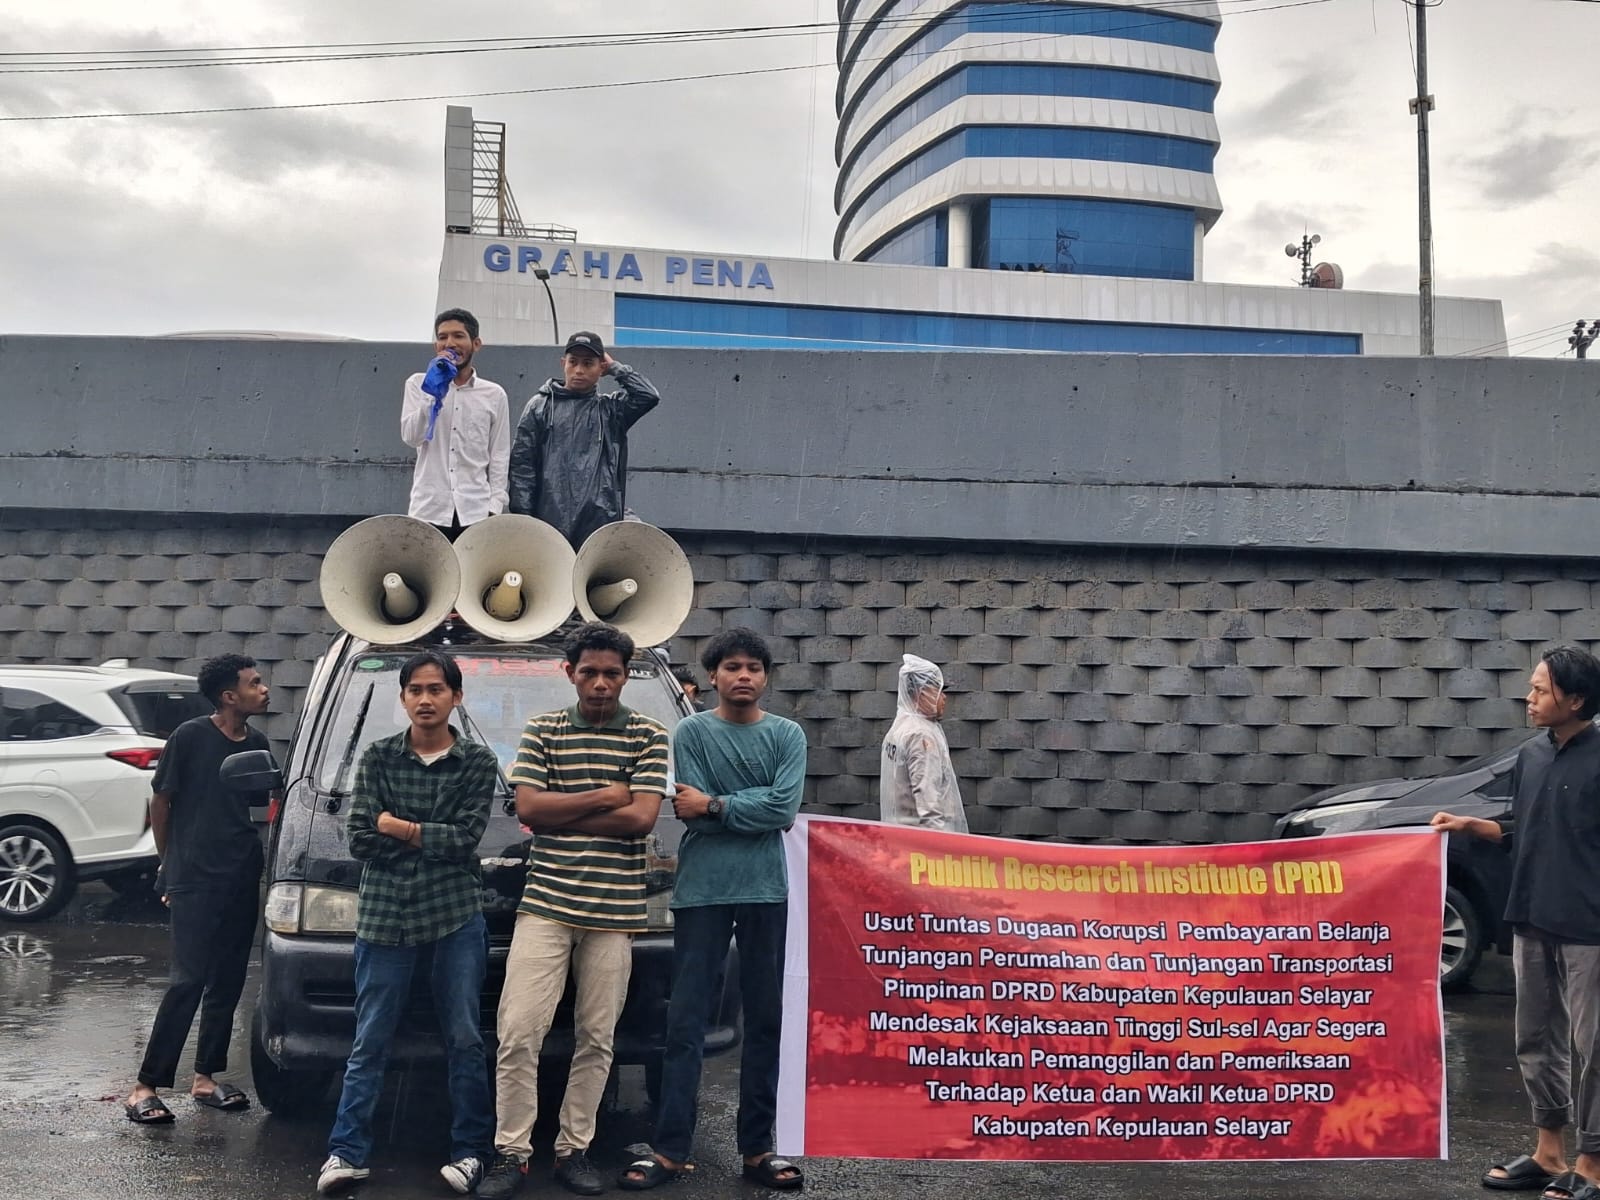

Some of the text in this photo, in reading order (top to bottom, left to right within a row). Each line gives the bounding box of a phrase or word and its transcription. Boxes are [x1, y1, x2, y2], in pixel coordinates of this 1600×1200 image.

[484, 244, 775, 290] GRAHA PENA
[910, 853, 1344, 895] Publik Research Institute (PRI)
[865, 912, 1390, 944] Usut Tuntas Dugaan Korupsi Pembayaran Belanja
[861, 945, 1392, 976] Tunjangan Perumahan dan Tunjangan Transportasi
[884, 979, 1373, 1009] Pimpinan DPRD Kabupaten Kepulauan Selayar
[870, 1012, 1386, 1041] Mendesak Kejaksaaan Tinggi Sul-sel Agar Segera
[909, 1046, 1350, 1074] Melakukan Pemanggilan dan Pemeriksaan
[925, 1081, 1334, 1106] Terhadap Ketua dan Wakil Ketua DPRD
[974, 1116, 1291, 1140] Kabupaten Kepulauan Selayar
